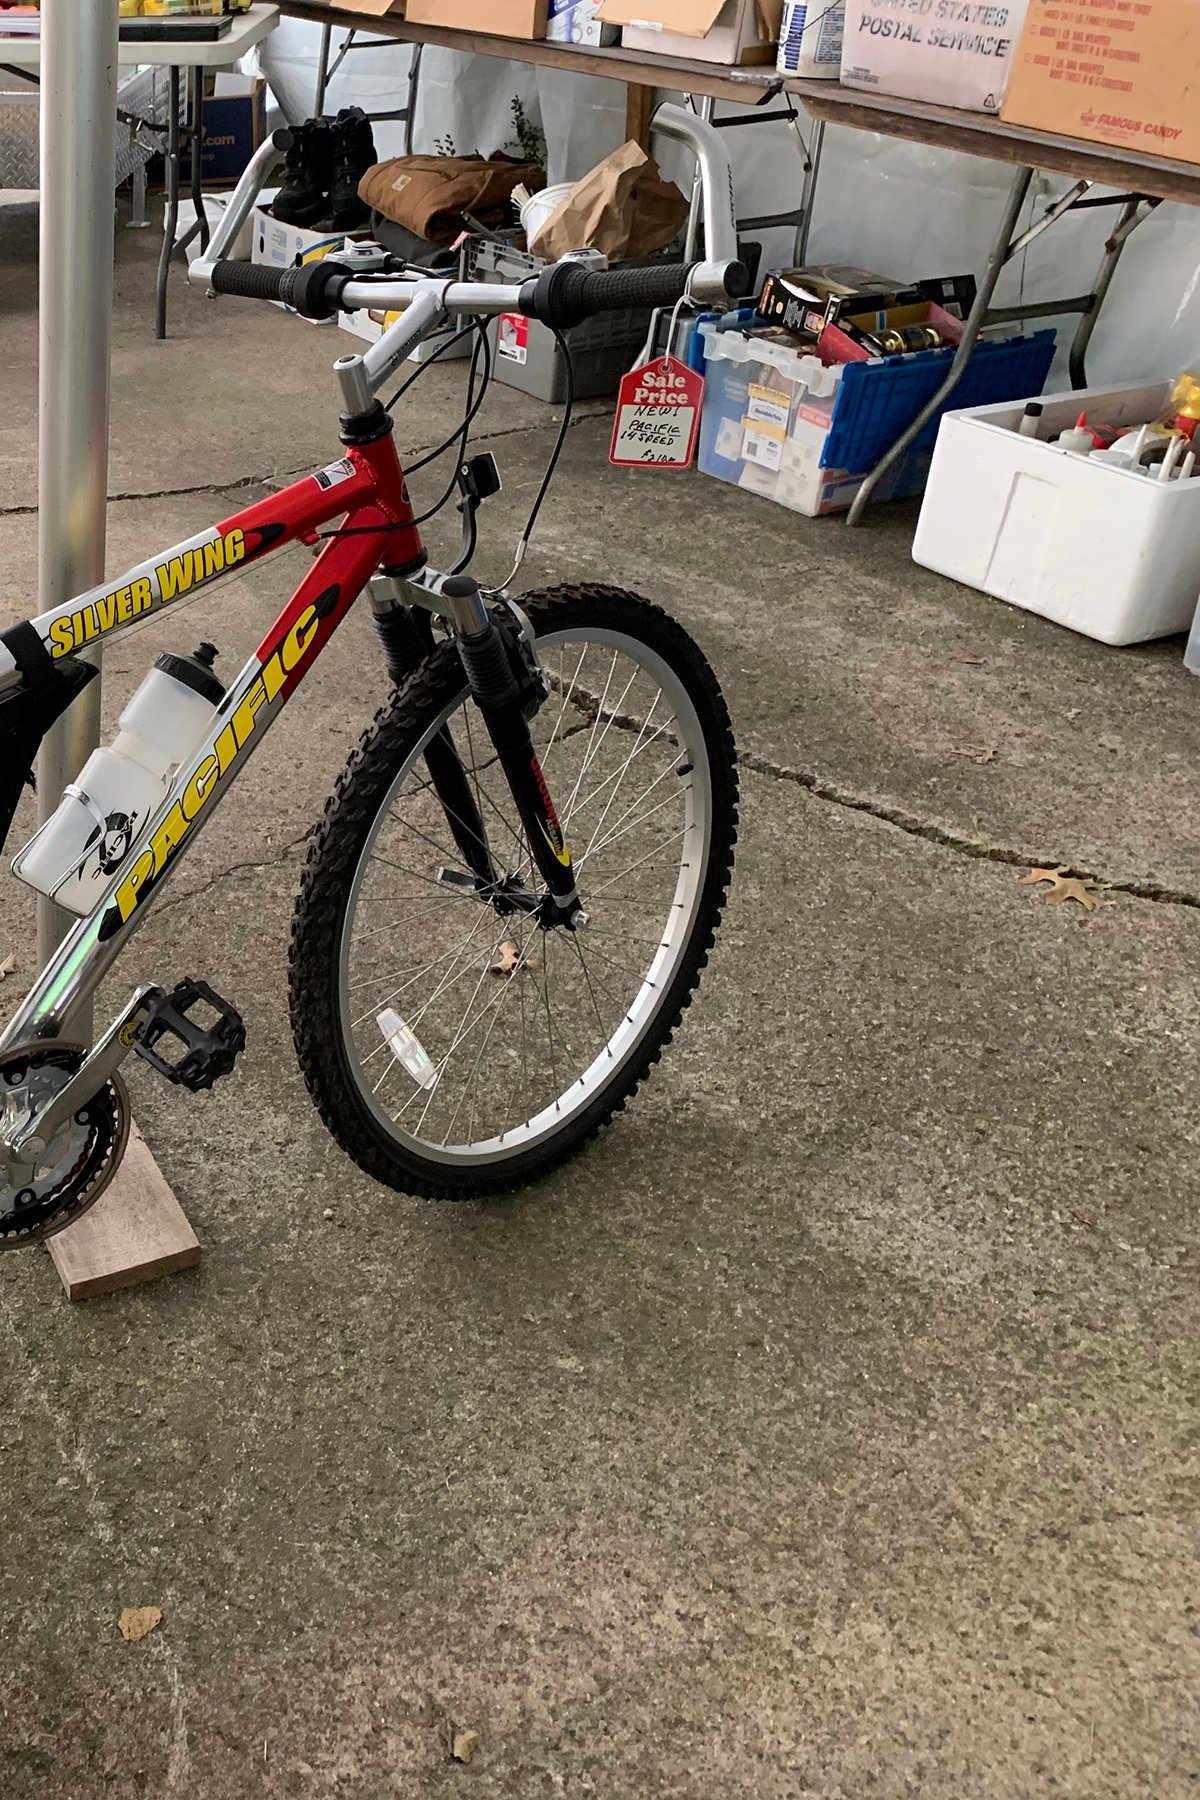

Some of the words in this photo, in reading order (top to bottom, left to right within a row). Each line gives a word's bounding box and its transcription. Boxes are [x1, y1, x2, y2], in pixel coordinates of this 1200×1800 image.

[934, 0, 1009, 28] STATES
[859, 13, 921, 43] POSTAL
[927, 27, 1011, 58] SERVICE
[1097, 114, 1142, 131] FAMOUS
[1144, 123, 1182, 140] CANDY
[642, 372, 686, 388] Sale
[633, 388, 688, 404] Price
[628, 420, 680, 434] PACIFIC
[638, 433, 673, 446] SPEED
[50, 576, 153, 660] SILVER
[155, 528, 246, 603] WING
[113, 603, 321, 924] PACIFIC
[91, 810, 139, 880] PACIFIC
